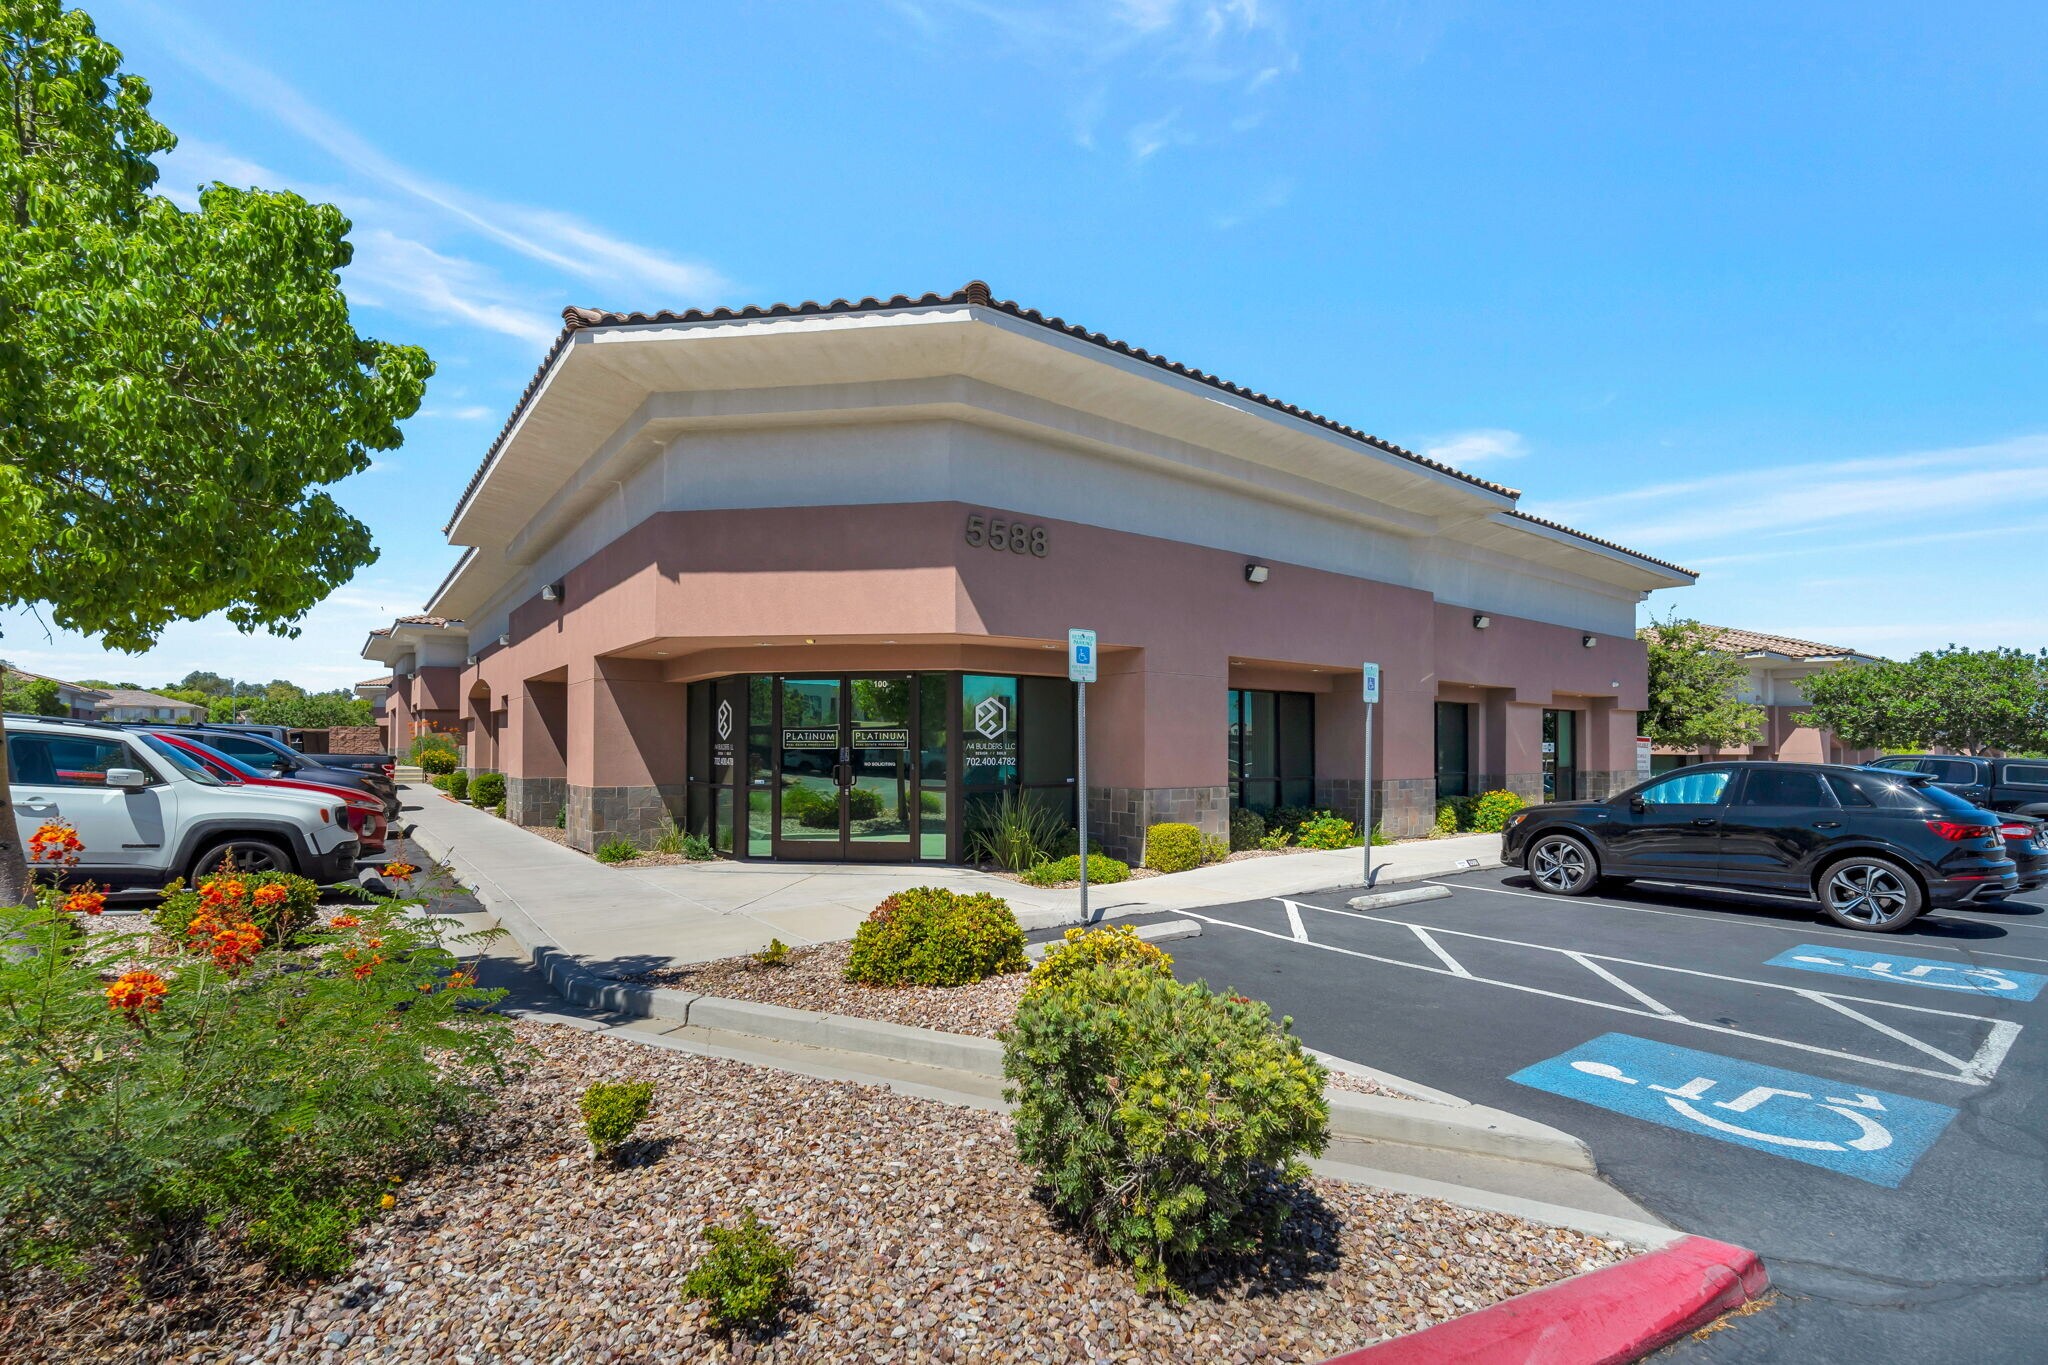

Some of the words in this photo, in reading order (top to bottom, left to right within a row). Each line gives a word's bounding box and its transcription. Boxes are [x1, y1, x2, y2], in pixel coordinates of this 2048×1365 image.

[966, 515, 1049, 558] 5588
[873, 680, 888, 688] 100
[786, 732, 835, 741] PLATINUM
[855, 732, 905, 741] PLATINUM
[965, 757, 1016, 766] 702.400.4782
